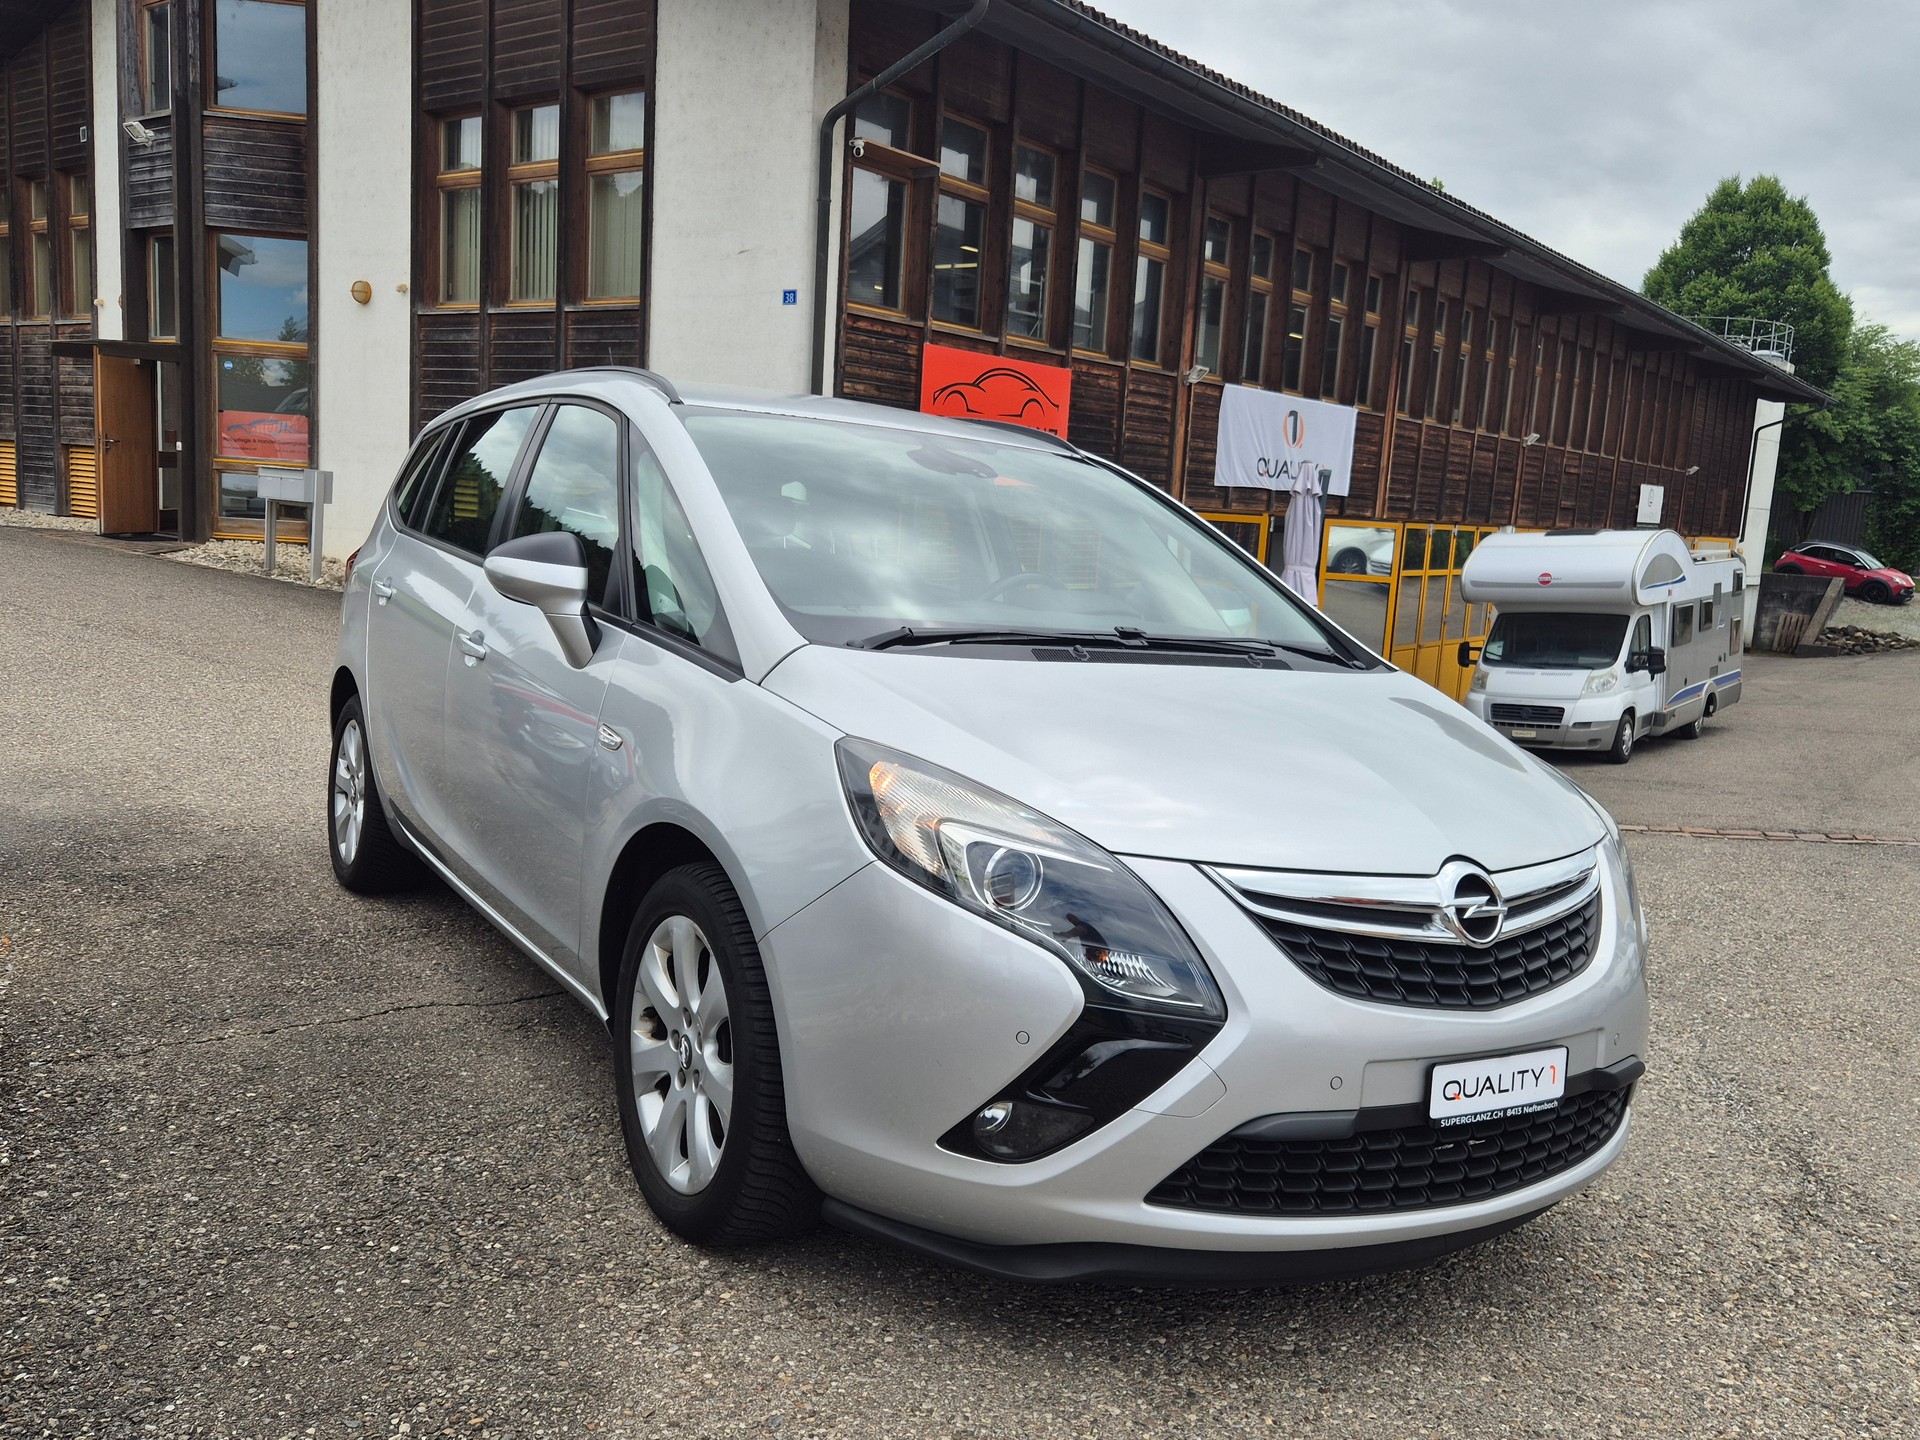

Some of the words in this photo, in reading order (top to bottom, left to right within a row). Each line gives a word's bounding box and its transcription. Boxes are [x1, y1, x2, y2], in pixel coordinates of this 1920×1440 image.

[1256, 457, 1319, 480] QUAL
[1442, 1066, 1545, 1101] QUALITY
[1549, 1064, 1557, 1085] 1
[1440, 1110, 1504, 1127] SUPERGLANZ.CH
[1523, 1100, 1559, 1114] Neftenbach
